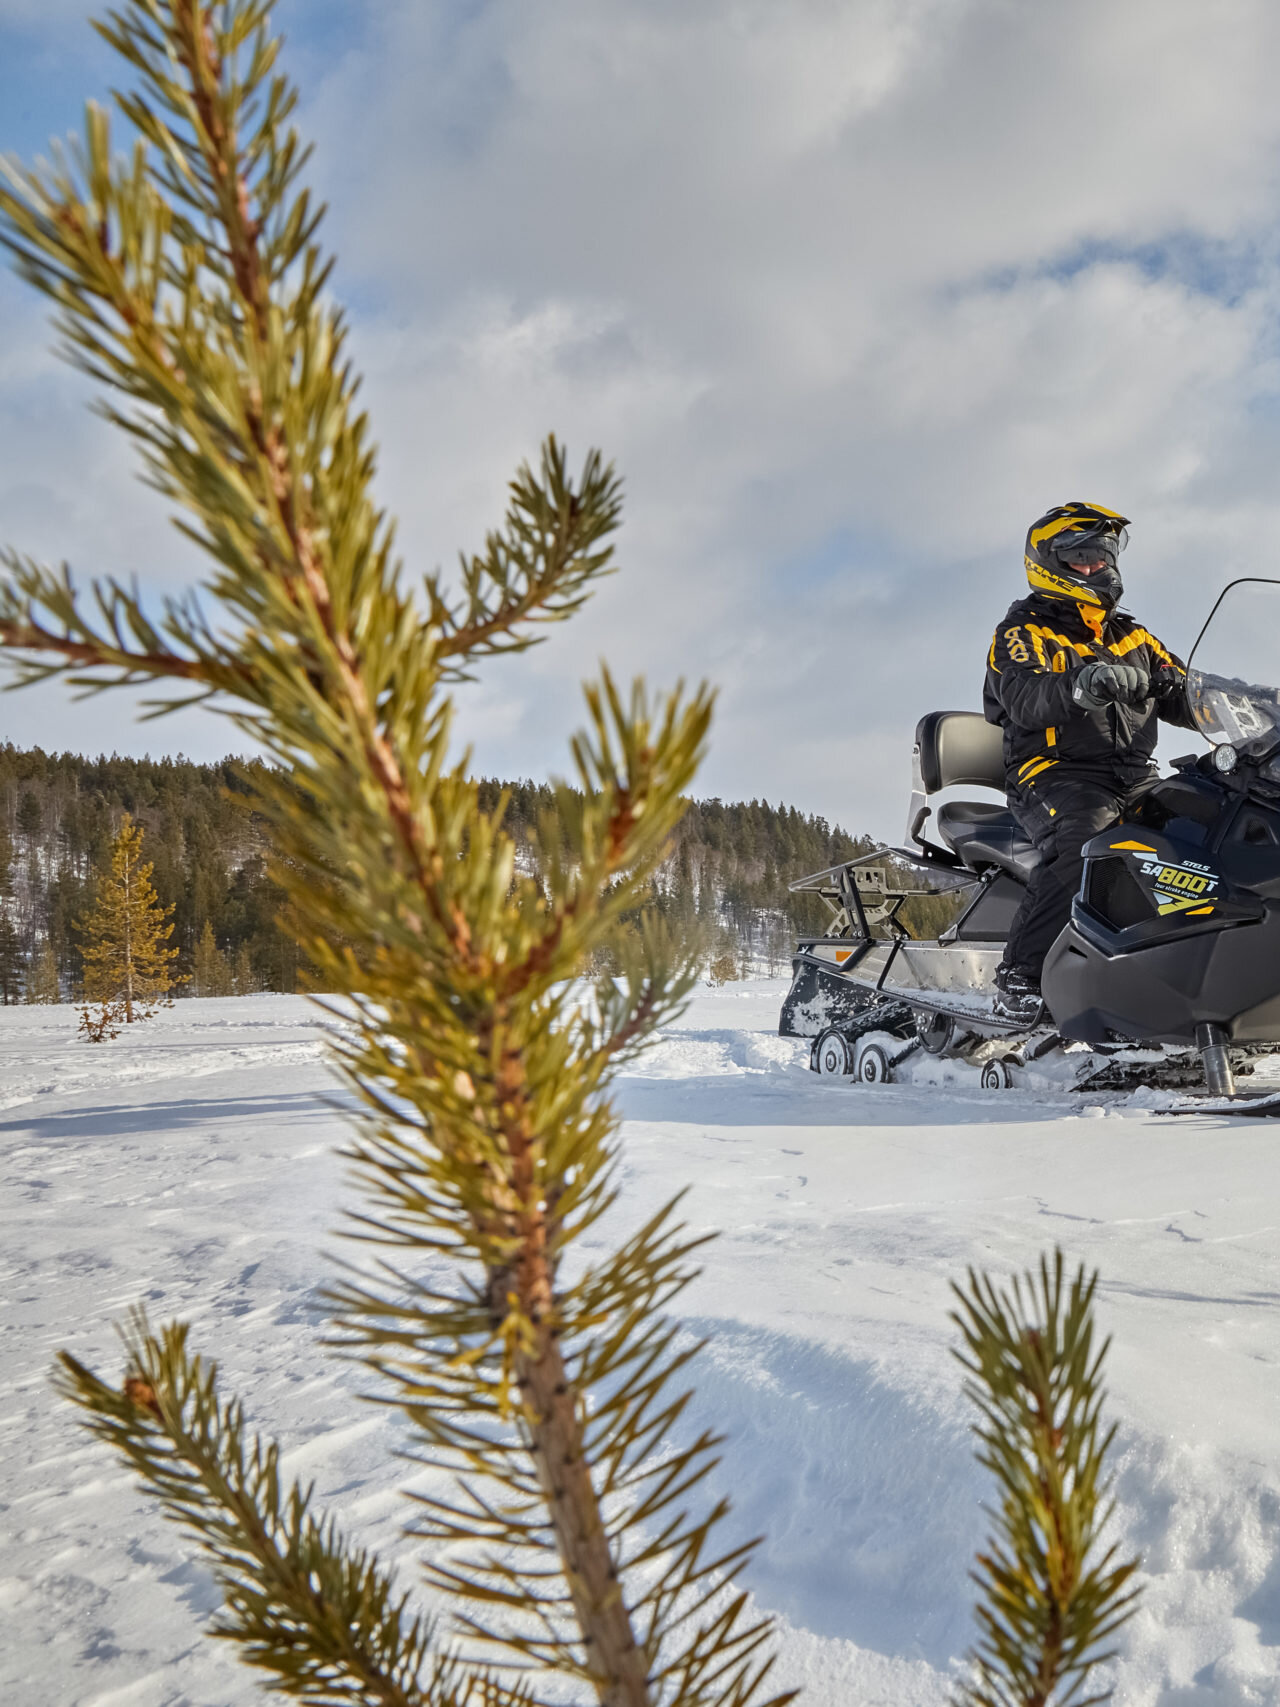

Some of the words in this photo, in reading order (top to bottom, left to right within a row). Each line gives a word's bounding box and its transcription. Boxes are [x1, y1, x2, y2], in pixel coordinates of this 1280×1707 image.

[1181, 860, 1211, 872] STELS
[1140, 862, 1219, 893] SA800T
[1154, 882, 1166, 890] four
[1165, 885, 1181, 894] stroke
[1181, 889, 1199, 899] engine
